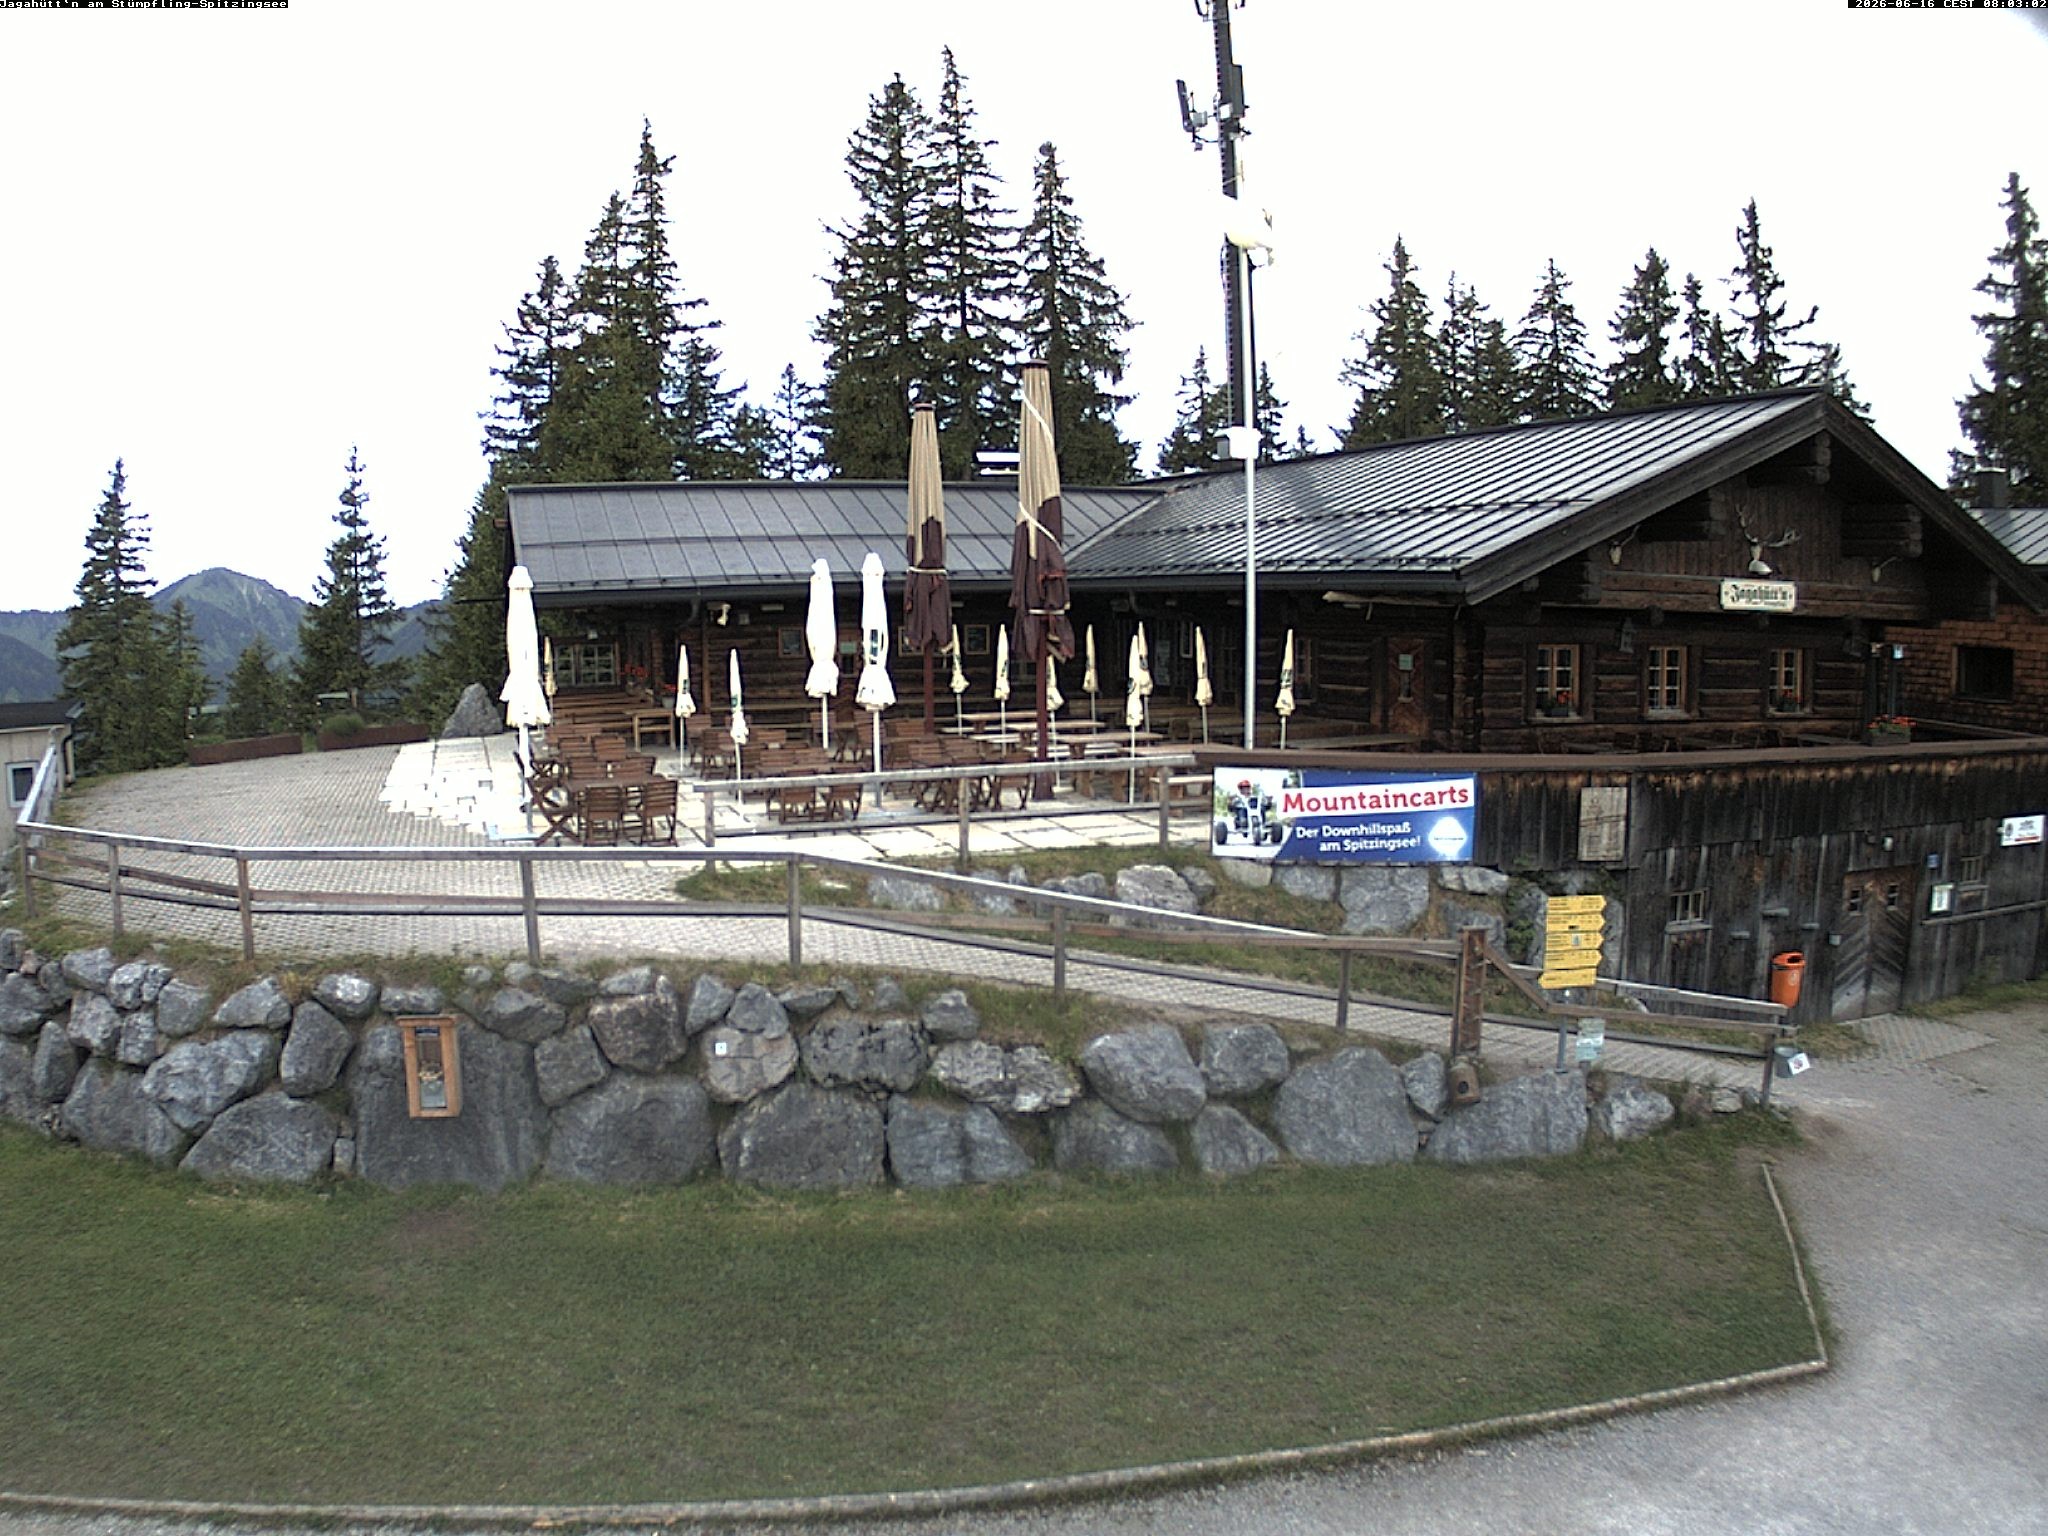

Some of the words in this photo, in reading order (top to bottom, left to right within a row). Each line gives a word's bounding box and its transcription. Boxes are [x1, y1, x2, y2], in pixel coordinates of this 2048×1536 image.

[1282, 786, 1469, 813] Mountaincarts
[1296, 826, 1318, 838] Der
[1322, 822, 1411, 838] Downhillspaß
[1320, 840, 1341, 852] am
[1344, 836, 1421, 853] Spitzingsee!
